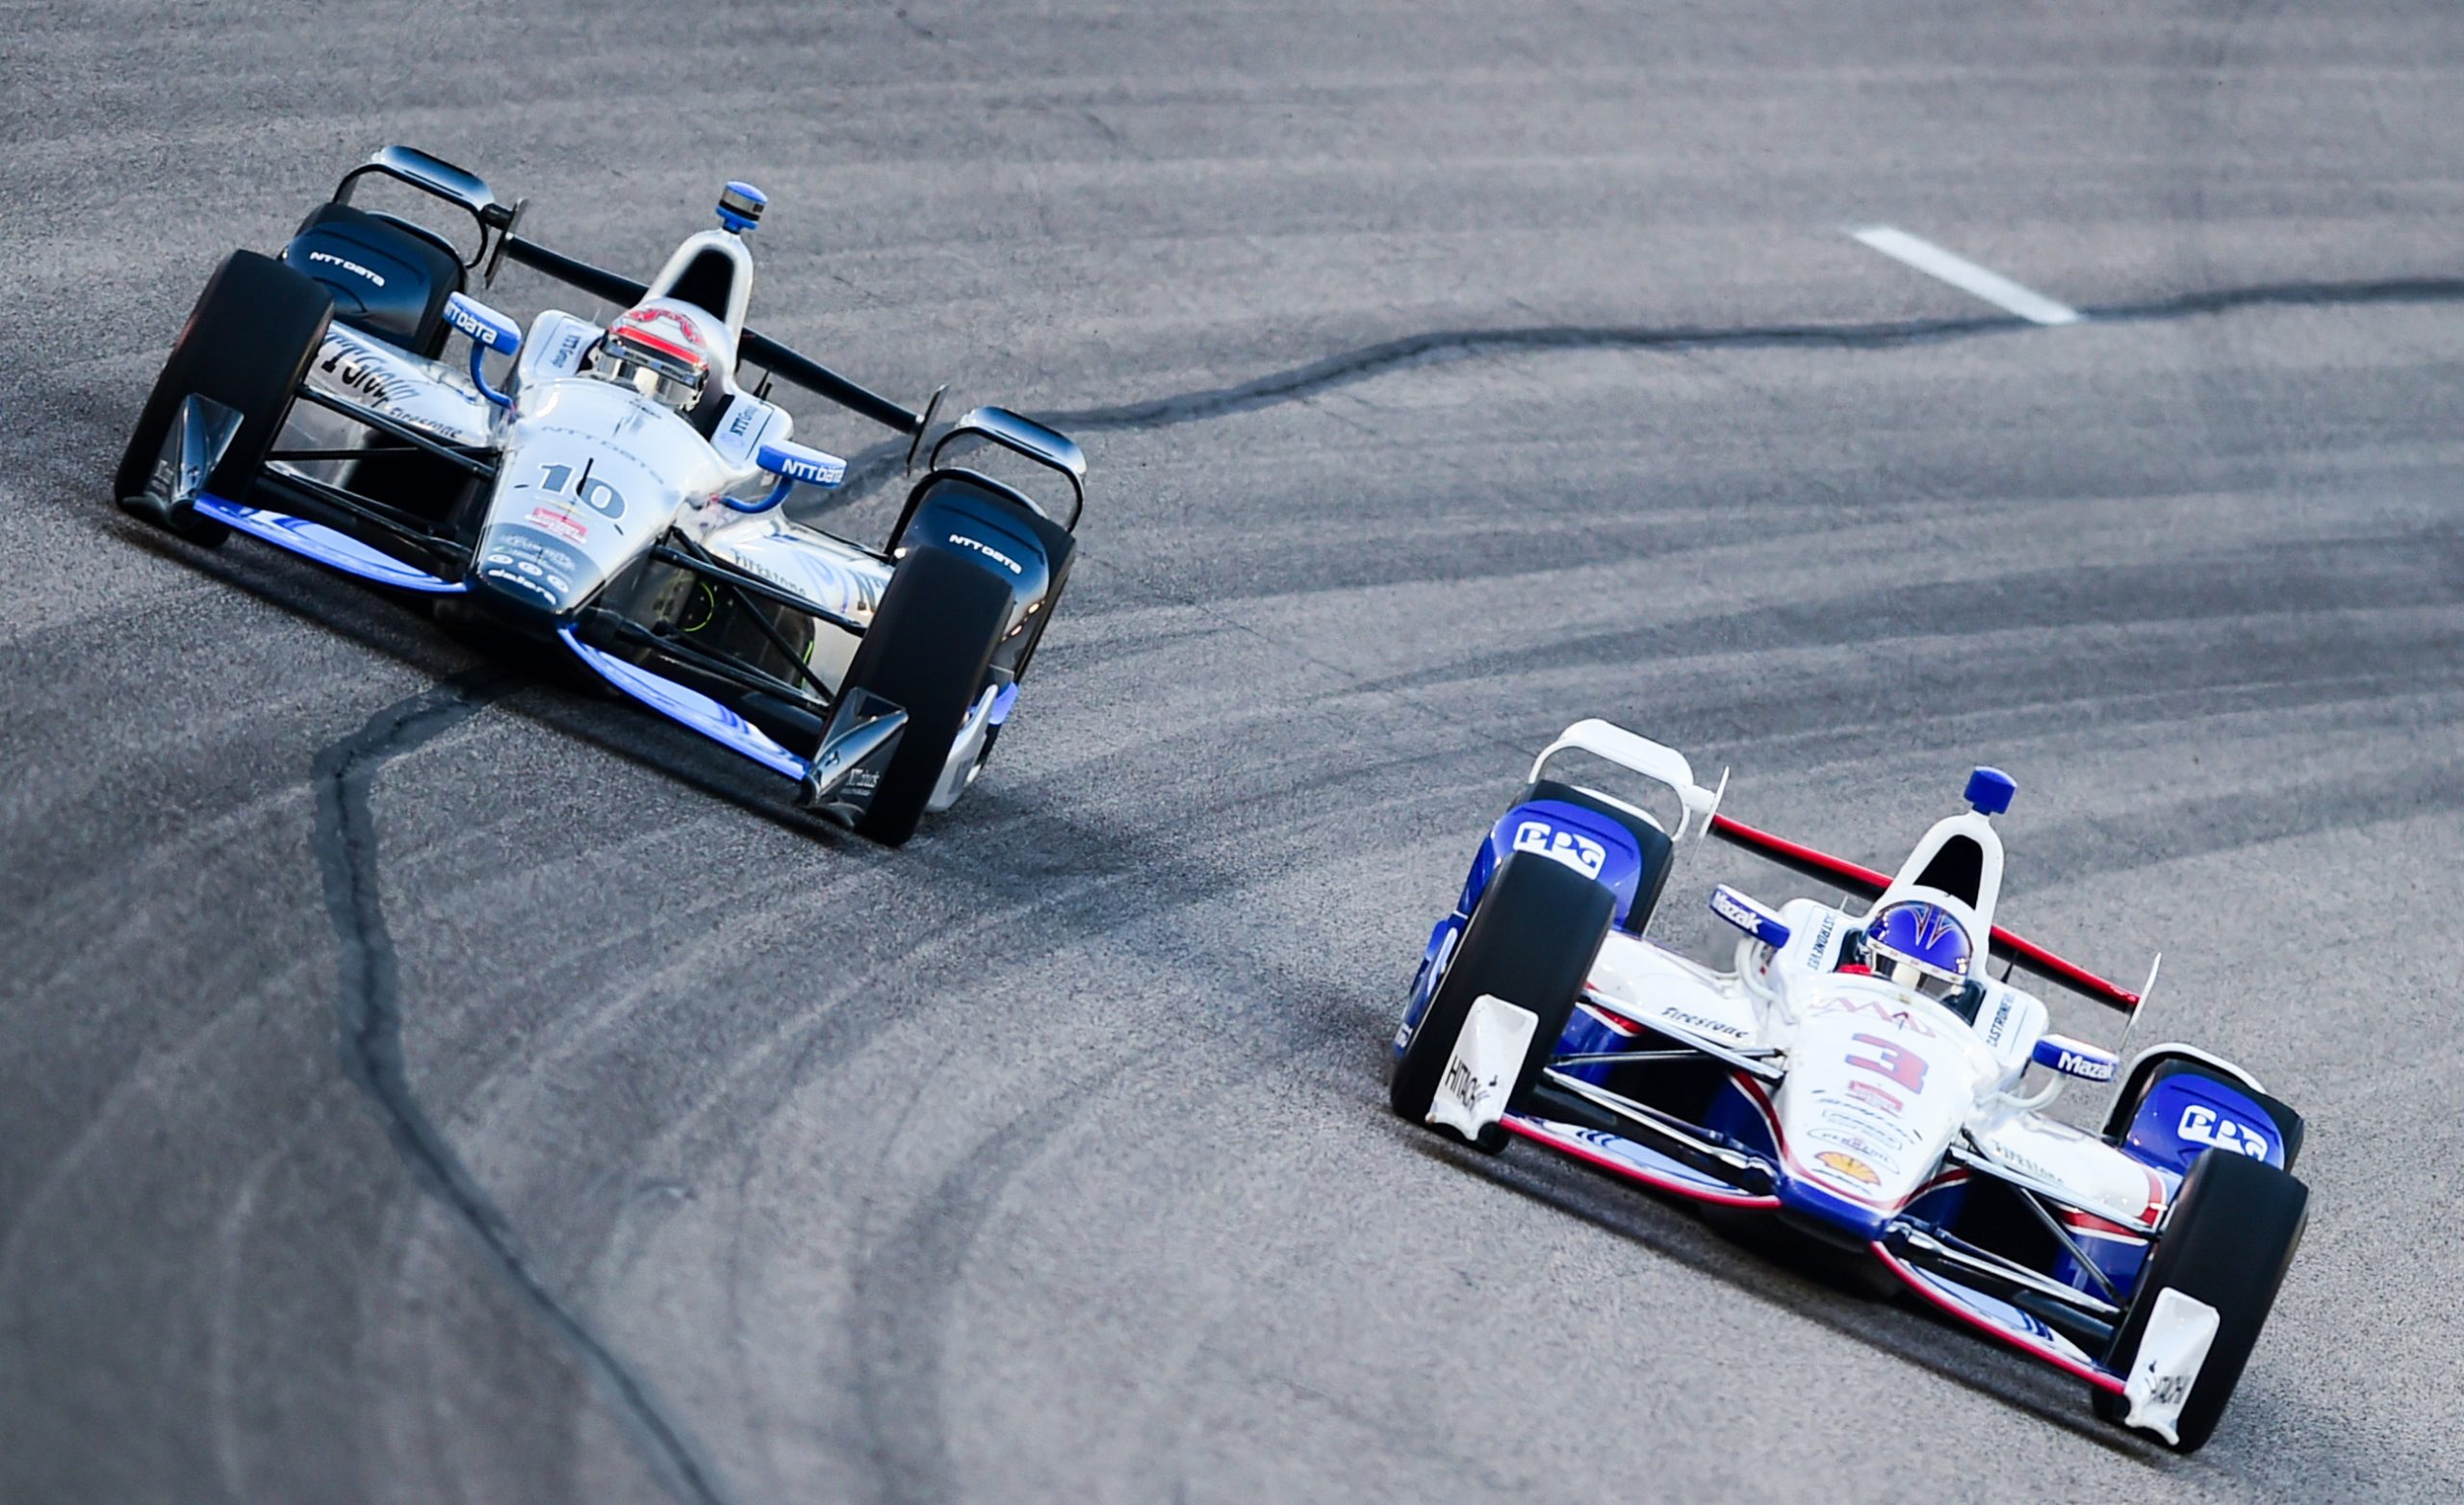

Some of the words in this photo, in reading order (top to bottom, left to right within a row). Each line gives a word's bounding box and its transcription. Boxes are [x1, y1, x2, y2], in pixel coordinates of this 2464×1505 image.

[309, 251, 345, 266] NTT
[389, 406, 462, 439] Firestone
[782, 458, 818, 480] NTT
[538, 464, 627, 521] 10
[949, 534, 983, 550] NTT
[1516, 824, 1604, 876] PPG
[1661, 1007, 1749, 1038] Firestone
[1844, 1033, 1929, 1095] 3
[2180, 1108, 2268, 1161] PPG
